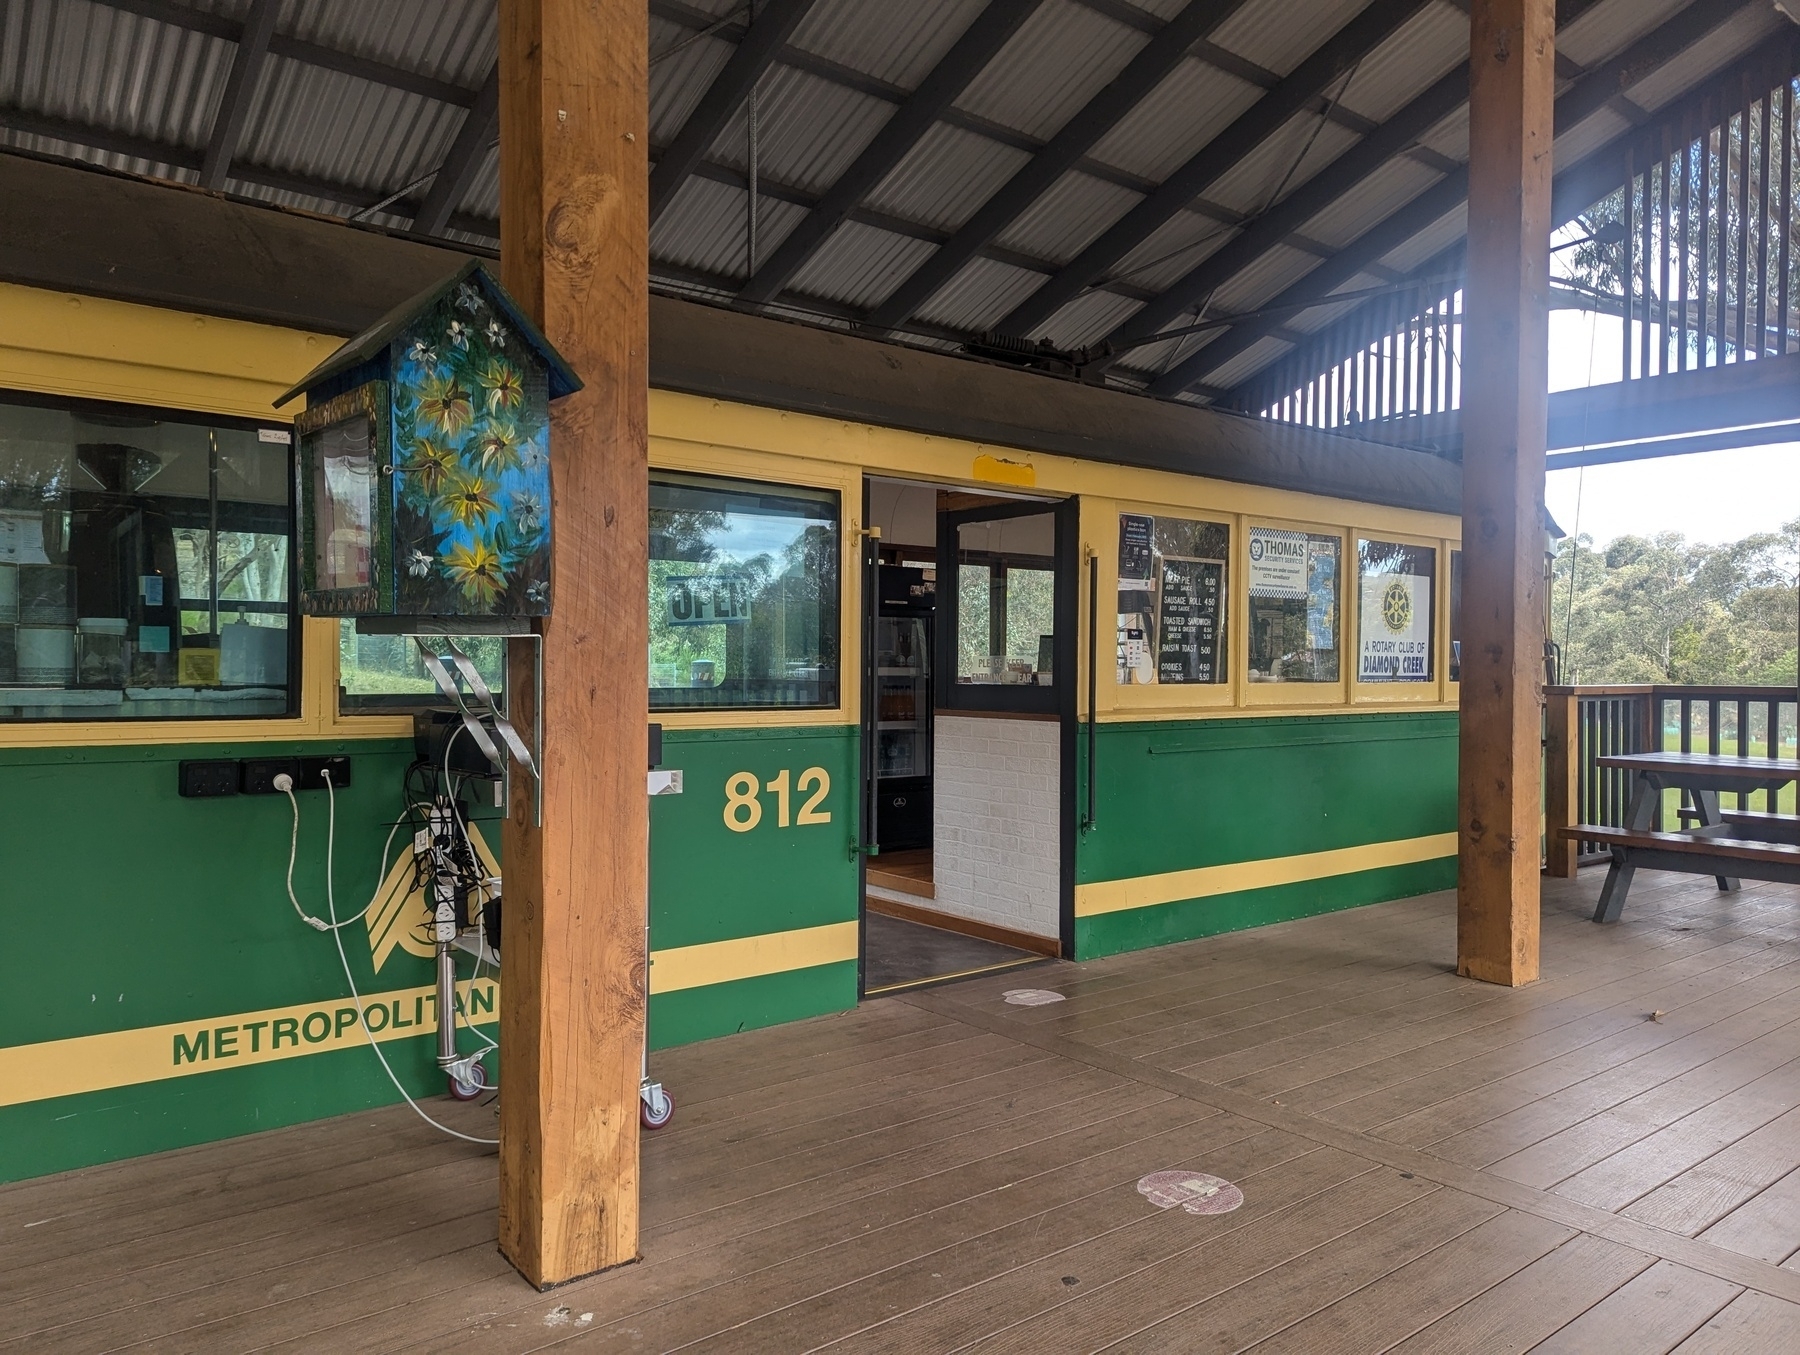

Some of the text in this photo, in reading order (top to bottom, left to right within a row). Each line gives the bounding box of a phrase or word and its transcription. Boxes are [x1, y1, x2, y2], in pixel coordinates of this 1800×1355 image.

[1264, 540, 1304, 557] THOMAS
[1284, 557, 1303, 565] SERVICES
[1182, 576, 1190, 584] PIE
[672, 582, 748, 620] OPEN
[1164, 596, 1186, 605] SAUSAGE
[1189, 597, 1202, 605] ROLL
[1163, 616, 1211, 626] TOASTED SANDWICH
[1162, 644, 1179, 652] RAISIN
[1364, 641, 1425, 653] A ROTARY CLUB OF
[1006, 659, 1024, 668] KEEP
[1161, 663, 1182, 671] COOKIES
[1364, 656, 1424, 673] DIAMOND CREEK
[724, 766, 831, 832] 812
[173, 986, 494, 1066] METROPOLITAN
